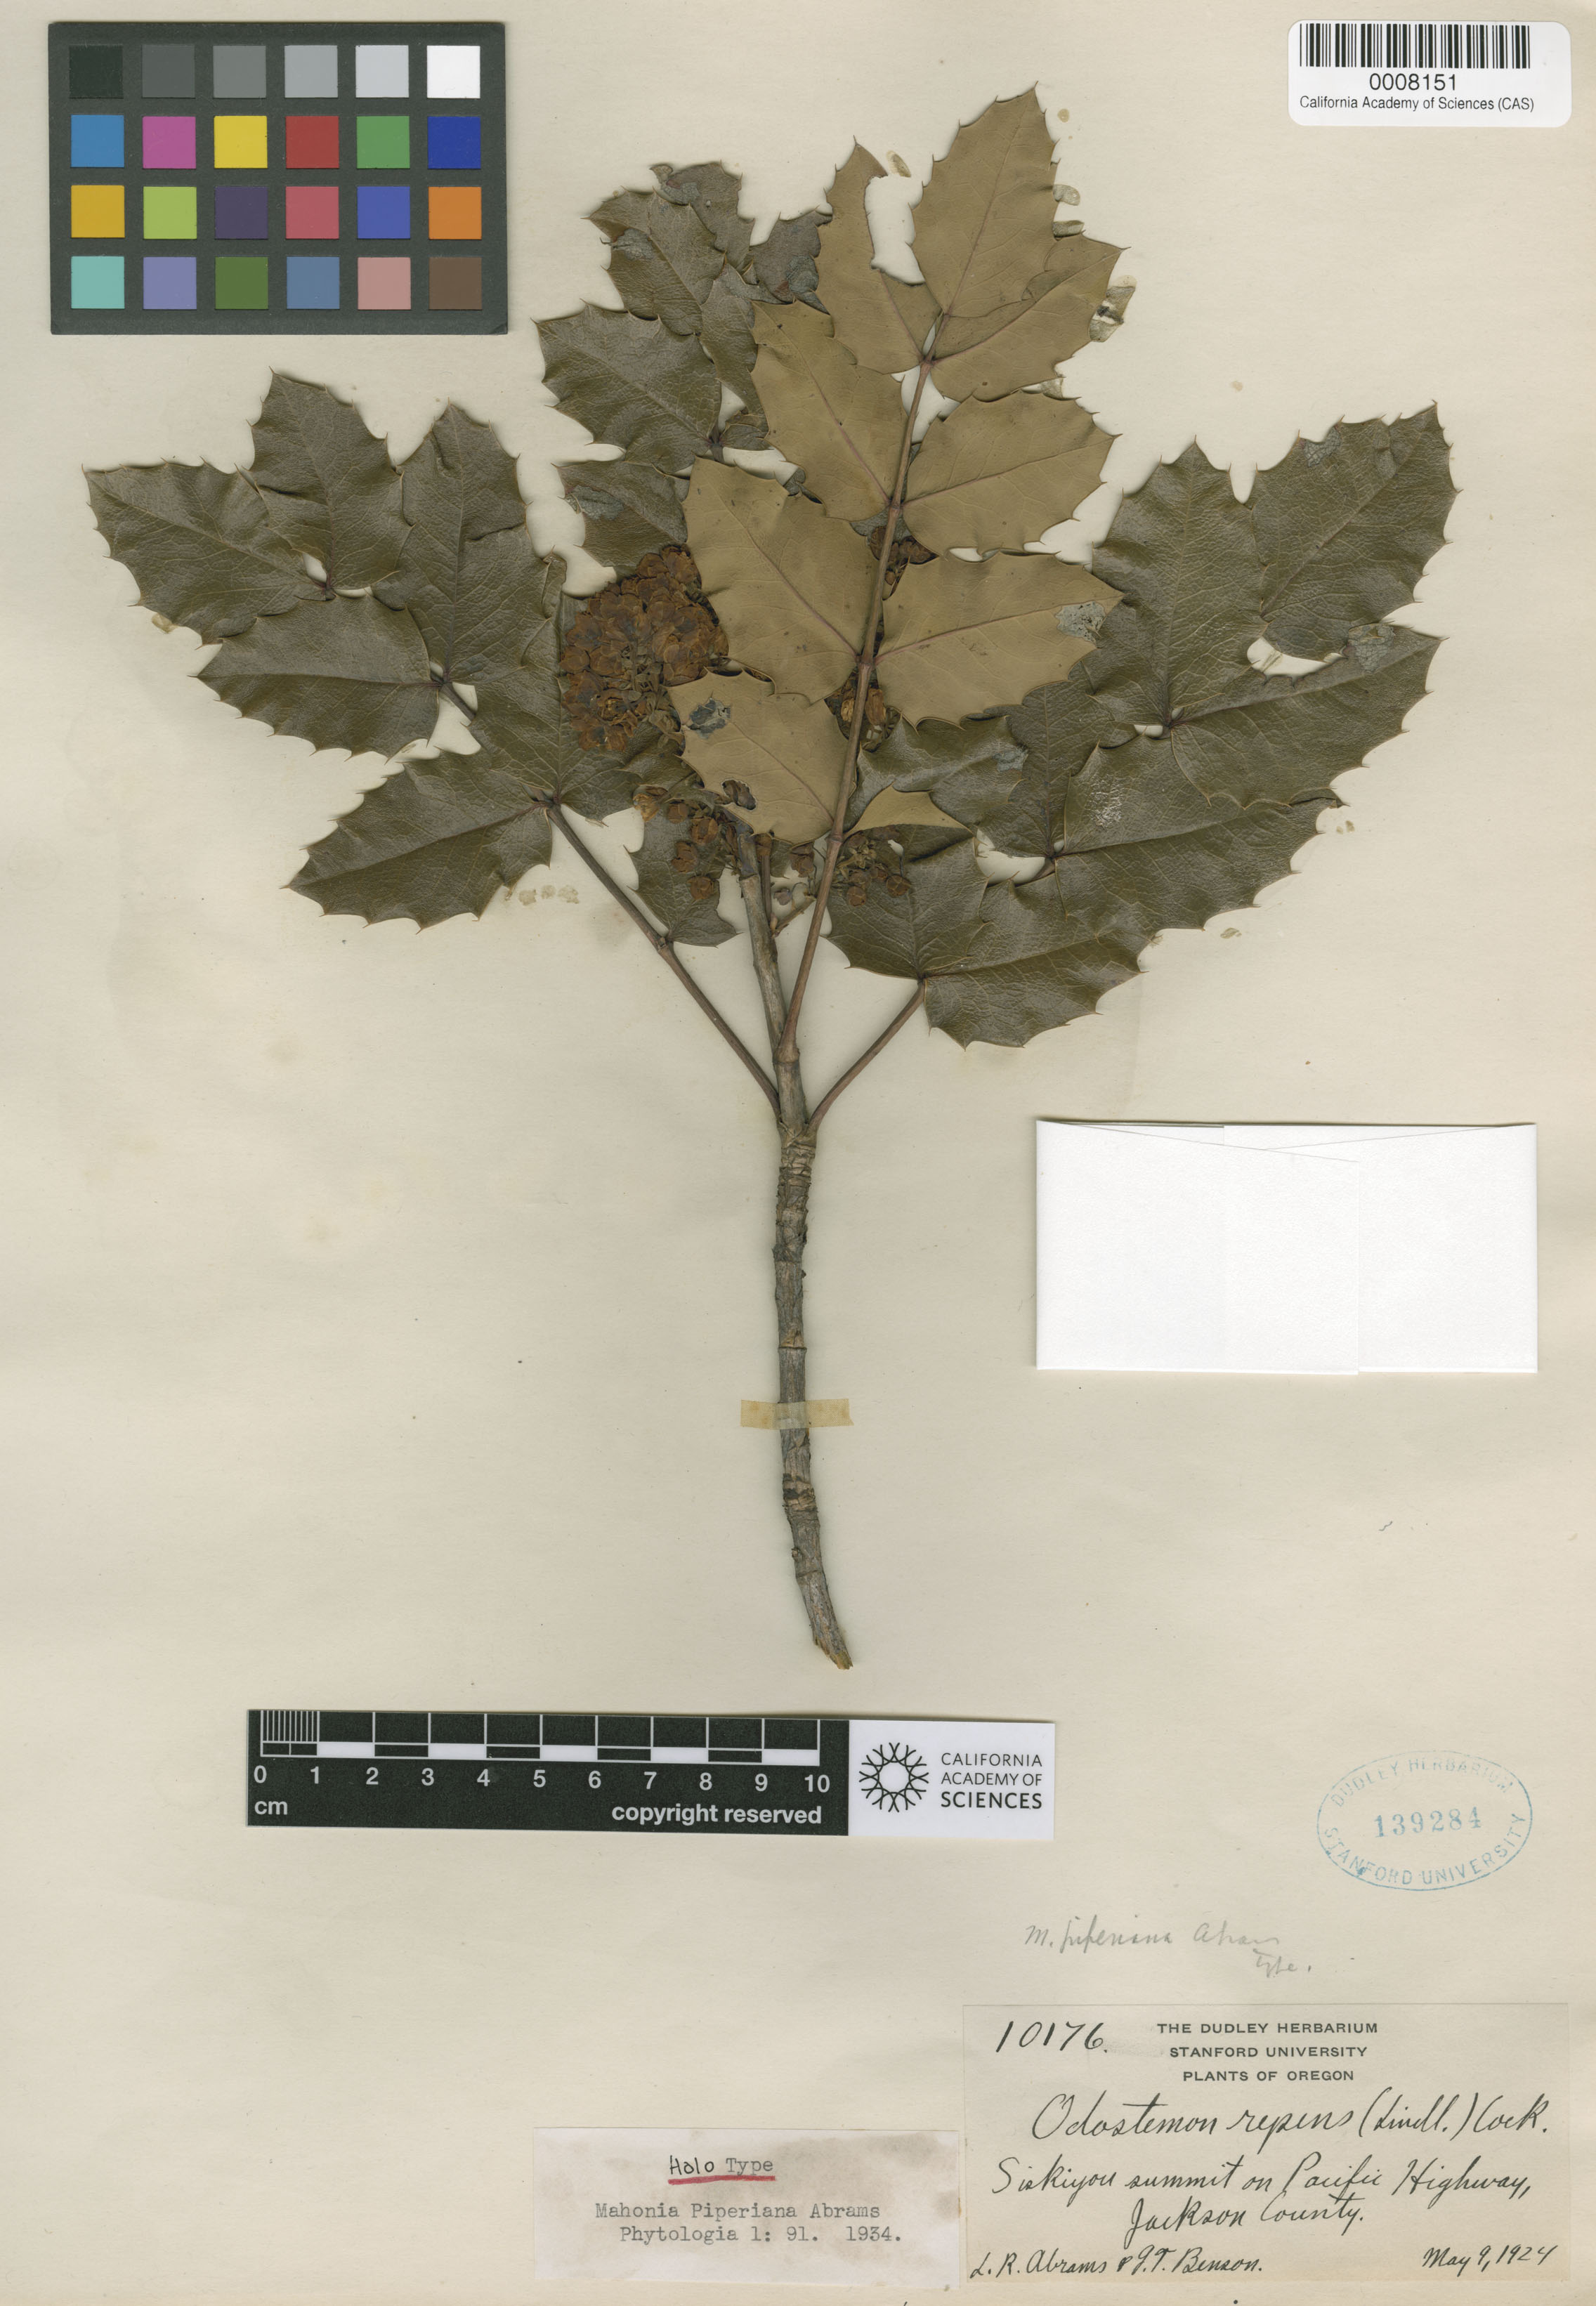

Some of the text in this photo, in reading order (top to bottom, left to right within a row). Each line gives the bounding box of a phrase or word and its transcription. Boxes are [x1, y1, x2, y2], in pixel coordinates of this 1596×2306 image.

[1369, 73, 1456, 91] 0008151
[1300, 96, 1534, 112] California Academy of Sciences (CAS)
[941, 1753, 1042, 1767] CALIFORNIA
[254, 1765, 830, 1793] 0 1 2 3 4 5 6 7 8 9 10
[941, 1772, 1042, 1787] ACADEMY OF
[1330, 1757, 1513, 1807] DUDLEY HERBARIUM
[254, 1800, 288, 1814] cm
[941, 1791, 1042, 1809] SCIENCES
[612, 1803, 822, 1825] copyright reserved
[1373, 1806, 1482, 1838] 139284
[1324, 1812, 1526, 1885] STANFORD UNIVERSITY
[1024, 1925, 1054, 1948] M.
[1157, 2023, 1378, 2033] THE DUDLEY HERBARIUM
[1170, 2046, 1367, 2057] STANFORD UNIVERSITY
[1183, 2071, 1354, 2081] PLANTS OF OREGON
[1031, 2090, 1217, 2139] Odostemon
[1227, 2109, 1354, 2154] repens
[726, 2158, 773, 2176] Type
[992, 2151, 1531, 2210] Siskiyou summit on Pacific Highway,
[596, 2203, 881, 2222] Mahonia Piperiana Abrams
[1124, 2196, 1246, 2249] Jackson
[620, 2226, 738, 2245] Phytologia
[846, 2227, 901, 2241] 1934.
[1026, 2248, 1107, 2274] Abrams
[1422, 2247, 1471, 2277] May
